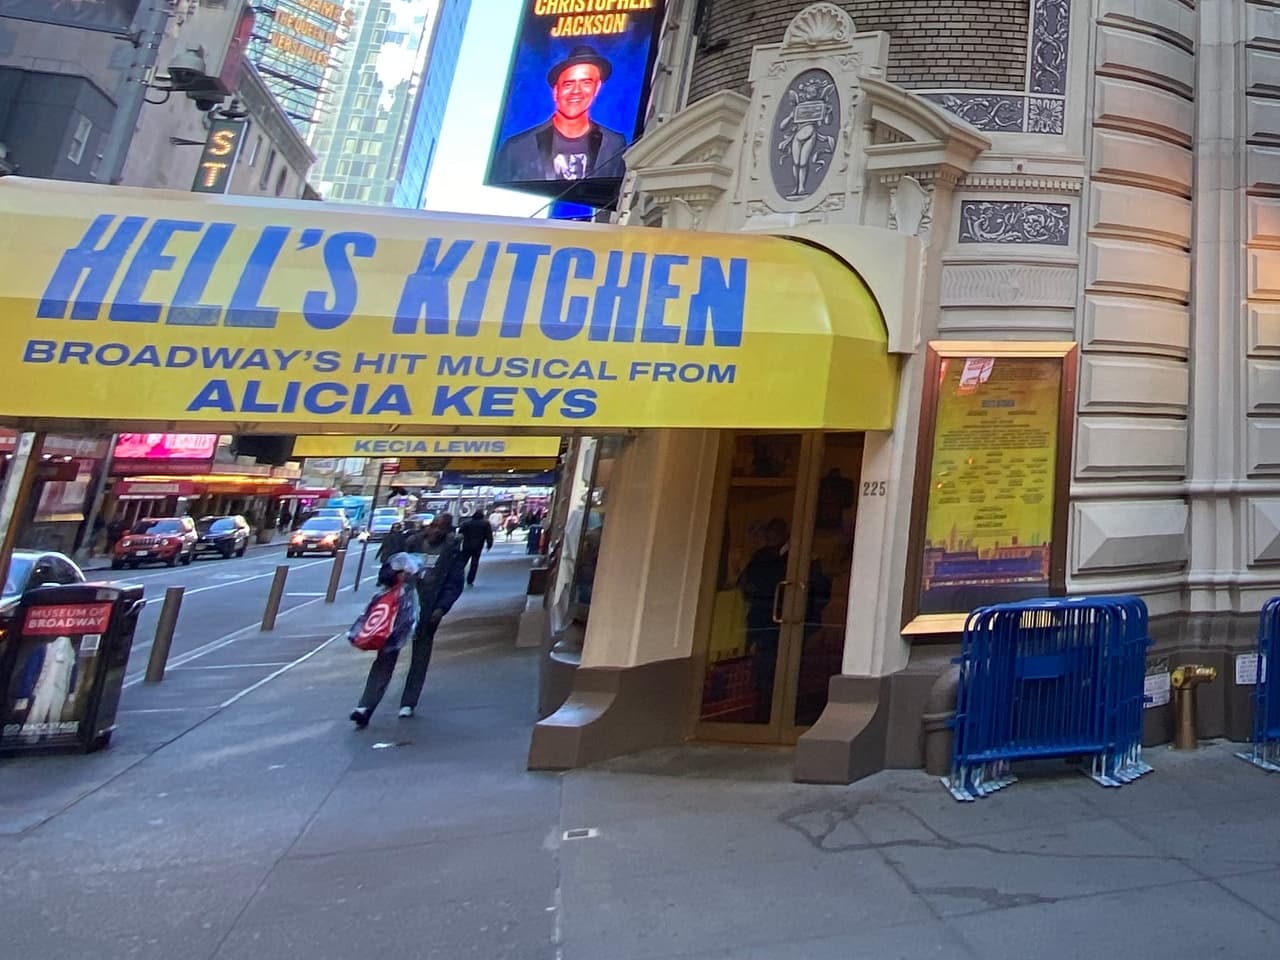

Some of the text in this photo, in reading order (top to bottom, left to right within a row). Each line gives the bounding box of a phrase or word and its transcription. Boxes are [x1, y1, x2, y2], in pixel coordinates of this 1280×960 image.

[551, 14, 627, 37] JACKSON
[36, 214, 748, 347] HELL'S KITCHEN
[23, 339, 737, 384] BROADWAY'S HIT MUSICAL FROM
[186, 378, 598, 419] ALICIA KEYS
[354, 440, 505, 453] KECIA LEWIS
[863, 481, 886, 496] 225
[31, 607, 104, 618] MUSEUM OF
[28, 617, 104, 629] BROADWAY
